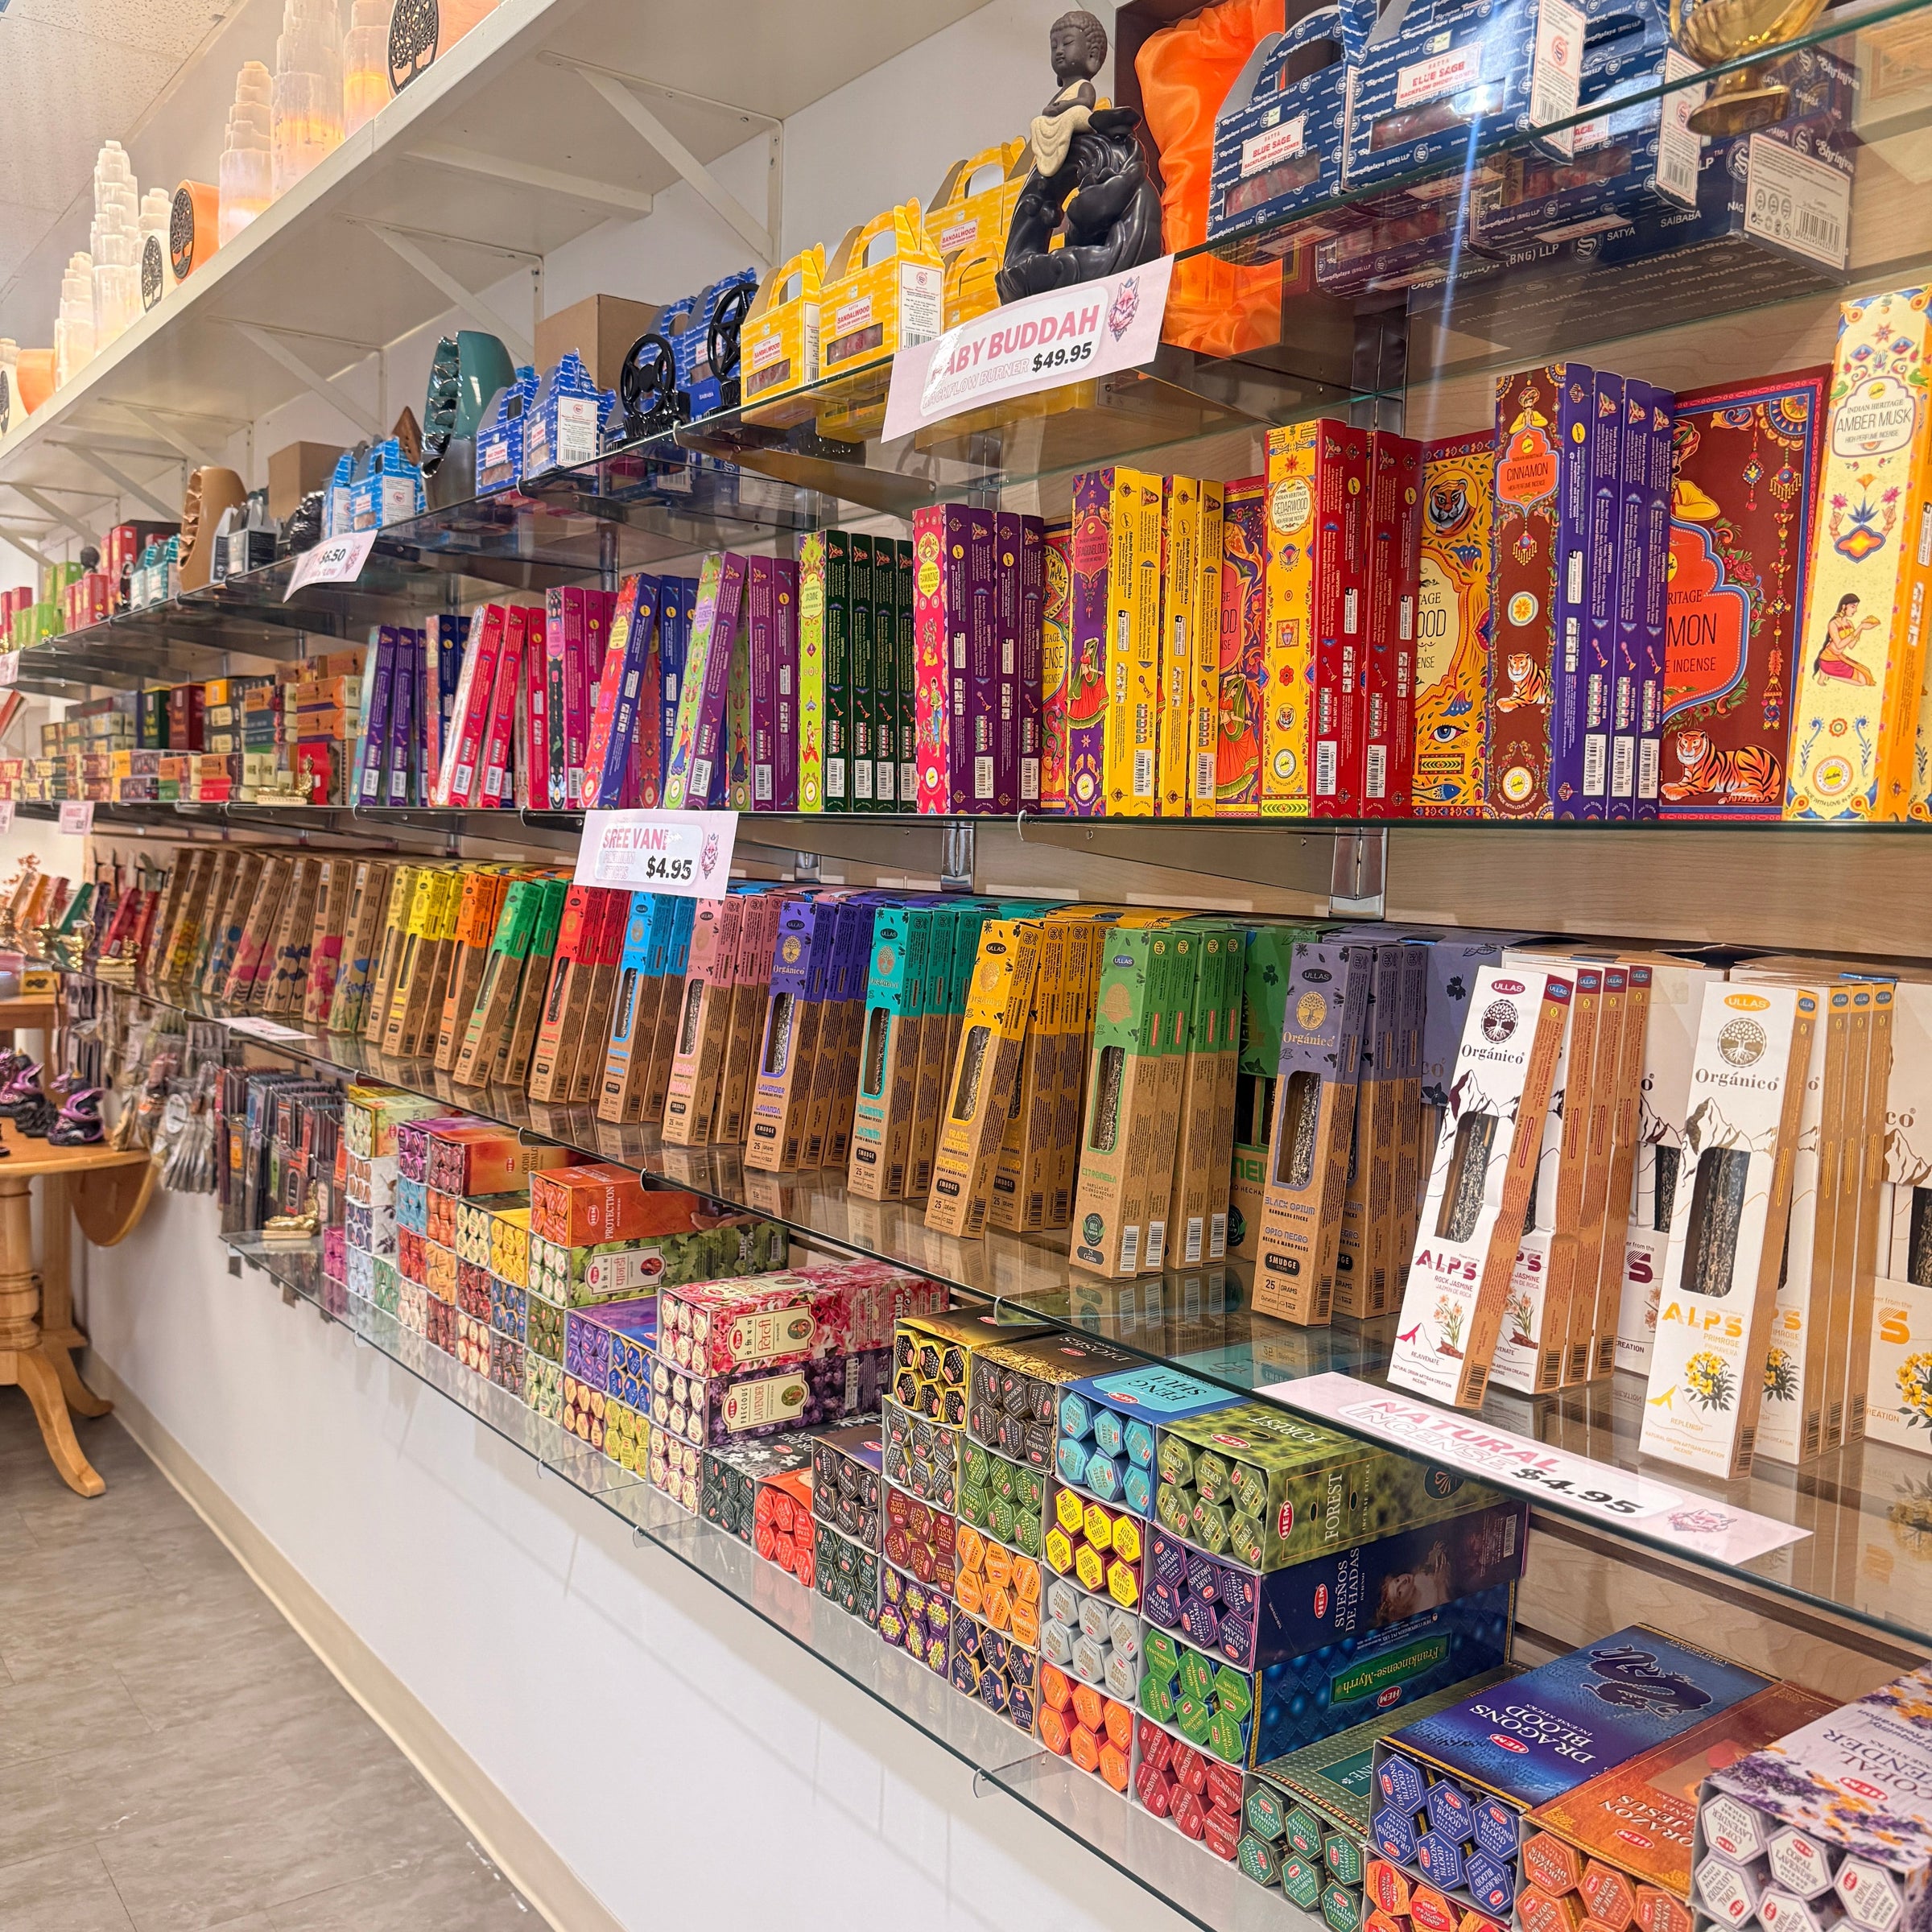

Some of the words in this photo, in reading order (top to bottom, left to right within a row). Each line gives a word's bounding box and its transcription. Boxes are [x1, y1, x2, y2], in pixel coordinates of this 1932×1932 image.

[1438, 60, 1465, 79] SAGE
[1253, 142, 1270, 158] BLUE
[1272, 134, 1291, 150] SAGE
[1726, 201, 1744, 213] NAG
[1660, 209, 1702, 229] SAIBABA
[942, 227, 976, 245] SANDALWOOD
[1607, 227, 1636, 242] SATYA
[1539, 243, 1560, 258] LLP
[837, 304, 871, 324] SANDALWOOD
[987, 304, 1100, 361] BUDDAH
[1032, 341, 1093, 374] $49.95
[979, 359, 1030, 386] BURNER
[1847, 404, 1871, 415] INDIAN
[1871, 399, 1905, 412] HERITAGE
[1835, 412, 1877, 433] AMBER
[1877, 407, 1913, 428] MUSK
[1505, 460, 1549, 483] CINNAMON
[1274, 497, 1309, 515] CEDARWOOD
[1673, 655, 1716, 675] INCENSE
[602, 828, 631, 848] SREE
[646, 855, 692, 881] $4.95
[987, 945, 1005, 953] ULLAS
[1114, 956, 1133, 966] ULLAS
[1302, 971, 1330, 980] ULLAS
[1579, 977, 1597, 987] ULLAS
[1494, 982, 1523, 993] ULLAS
[1549, 985, 1568, 997] ULLAS
[1876, 992, 1892, 1003] ULLAS
[1728, 997, 1768, 1008] ULLAS
[1798, 998, 1814, 1009] ULLAS
[1282, 1030, 1336, 1048] Orgánico
[1460, 1043, 1523, 1066] Orgánico
[757, 1084, 786, 1095] LAVENDER
[1694, 1067, 1777, 1092] Orgánico
[757, 1124, 774, 1133] SMUDGE
[753, 1141, 762, 1150] 25
[937, 1156, 969, 1172] INCIENSO
[939, 1180, 958, 1191] SMUDGE
[1080, 1167, 1117, 1183] CITRONELLA
[605, 1185, 615, 1240] PROTECTION
[1264, 1196, 1288, 1209] BLACK
[1290, 1201, 1315, 1216] OPIUM
[1269, 1209, 1293, 1219] HANDMADE
[1293, 1214, 1309, 1224] STICKS
[1262, 1236, 1277, 1245] HECHO
[1280, 1241, 1294, 1249] MANO
[1294, 1245, 1309, 1253] PALOS
[1264, 1225, 1283, 1236] OPIO
[1285, 1230, 1307, 1243] NEGRO
[1633, 1241, 1645, 1251] from
[1645, 1245, 1655, 1253] the
[1269, 1256, 1298, 1270] SMUDGE
[1415, 1249, 1478, 1282] ALPS
[1265, 1278, 1275, 1290] 25
[1280, 1285, 1298, 1294] GRAMS
[1435, 1275, 1449, 1286] ROCK
[1449, 1278, 1473, 1293] JASMINE
[1513, 1272, 1539, 1283] JASMINE
[1885, 1298, 1900, 1307] from
[1901, 1299, 1913, 1309] the
[1662, 1301, 1744, 1338] ALPS
[1061, 1336, 1132, 1362] DIOSES
[1702, 1331, 1740, 1349] PRIMROSE
[1410, 1351, 1441, 1365] REJUVENATE
[1151, 1375, 1208, 1397] SHUI
[1393, 1364, 1409, 1373] NATURAL
[1407, 1368, 1420, 1378] ORIGIN
[1418, 1372, 1435, 1383] ARTISAN
[1435, 1377, 1452, 1388] CREATION
[1412, 1378, 1428, 1386] INCENSE
[1111, 1391, 1138, 1404] HEM
[1127, 1378, 1188, 1402] FENG
[728, 1399, 736, 1418] HEM
[741, 1388, 749, 1425] PRECIOUS
[753, 1385, 765, 1422] LAVENDER
[1246, 1415, 1328, 1444] FOREST
[1670, 1417, 1703, 1433] REPLENISH
[1214, 1435, 1248, 1447] HEM
[1346, 1407, 1517, 1472] INCENSE
[1368, 1399, 1562, 1473] NATURAL
[1645, 1431, 1666, 1443] NATURAL
[1666, 1436, 1681, 1447] ORIGIN
[1681, 1441, 1702, 1454] ARTISAN
[1700, 1446, 1726, 1460] CREATION
[1162, 1449, 1183, 1470] FOREST
[1199, 1463, 1222, 1486] FOREST
[1240, 1478, 1259, 1505] FOREST
[1512, 1467, 1644, 1513] $4.95
[1059, 1499, 1074, 1513] FENG
[1063, 1509, 1077, 1521] SHUI
[1323, 1473, 1343, 1542] FOREST
[1087, 1517, 1103, 1530] FENG
[1203, 1515, 1219, 1541] FOREST
[1282, 1502, 1291, 1538] HEM
[1092, 1526, 1106, 1538] SHUI
[1156, 1547, 1172, 1565] FAIRY
[1158, 1552, 1180, 1575] DREAMS
[1346, 1547, 1360, 1607] HADAS
[1315, 1586, 1325, 1618] HEM
[1335, 1560, 1349, 1629] SUEÑOS
[1344, 1607, 1357, 1633] DE
[1220, 1623, 1249, 1649] DREAMS
[1222, 1634, 1245, 1652] FAIRY
[1343, 1645, 1441, 1694] Frankincense-Myrrh
[1380, 1689, 1401, 1705] HEM
[1523, 1703, 1555, 1718] STICKS
[1468, 1703, 1596, 1765] DRAGONS
[1505, 1705, 1596, 1748] BLOOD
[1552, 1716, 1594, 1737] INCENSE
[1856, 1708, 1926, 1740] Relaxation
[1492, 1734, 1528, 1753] HEM
[1389, 1763, 1406, 1806] DRAGONS
[1397, 1769, 1410, 1800] BLOOD
[1840, 1750, 1932, 1800] COPAL
[1433, 1794, 1470, 1827] DRAGONS
[1444, 1792, 1462, 1810] HEM
[1618, 1794, 1689, 1829] JESUS
[1248, 1798, 1280, 1829] EGYPTIAN
[1249, 1808, 1277, 1831] JASMINE
[1436, 1805, 1462, 1829] BLOOD
[1711, 1806, 1753, 1842] LAVENDER
[1478, 1810, 1515, 1843] DRAGONS
[1480, 1823, 1507, 1847] BLOOD
[1716, 1821, 1744, 1845] COPAL
[1616, 1829, 1655, 1848] HEM
[1774, 1848, 1818, 1887] LAVENDER
[1785, 1847, 1813, 1871] COPAL
[1286, 1868, 1312, 1893] EGYPTIAN
[1291, 1876, 1314, 1898] JASMINE
[1589, 1876, 1613, 1913] CORAZON
[1597, 1906, 1605, 1918] DE
[1604, 1884, 1620, 1908] JESUS
[1853, 1879, 1872, 1905] COPAL
[1858, 1880, 1887, 1921] LAVENDER
[1323, 1893, 1357, 1921] EGYPTIAN
[1325, 1903, 1354, 1926] JASMINE
[1415, 1906, 1446, 1924] DRAGONS
[1422, 1900, 1438, 1913] HEM
[1420, 1914, 1441, 1927] BLOOD
